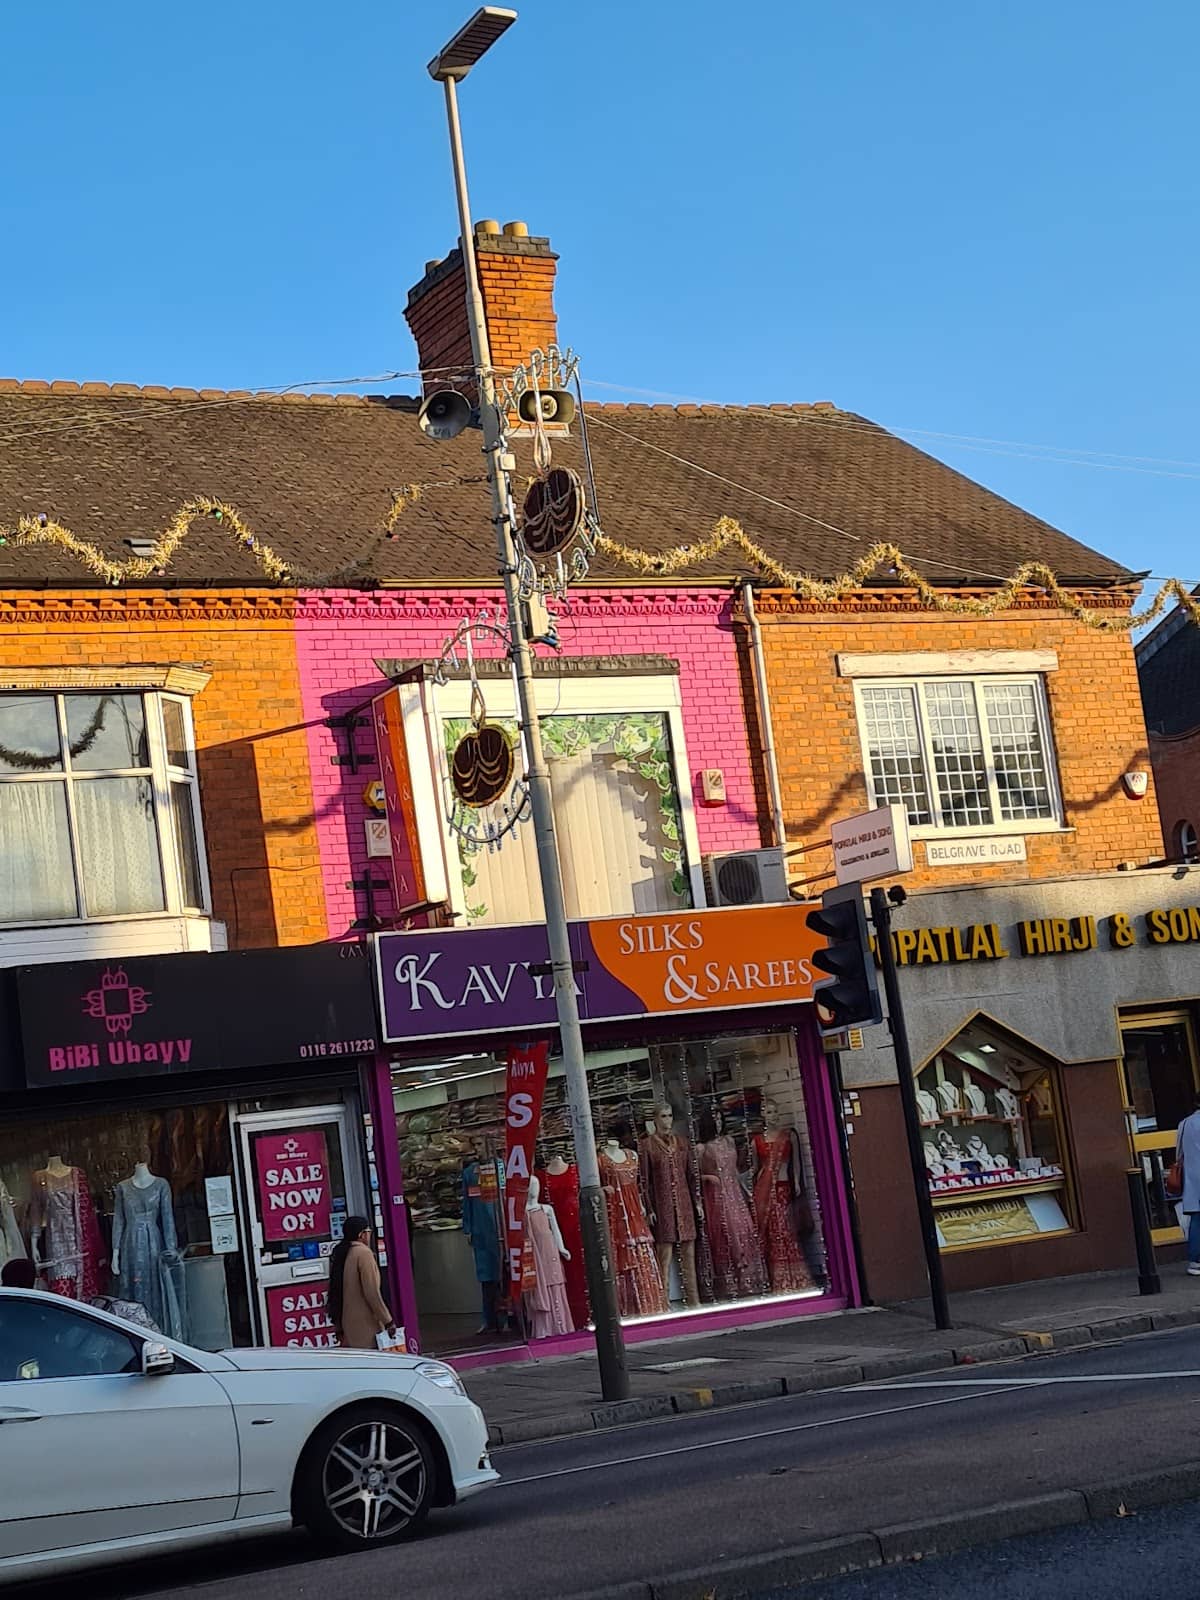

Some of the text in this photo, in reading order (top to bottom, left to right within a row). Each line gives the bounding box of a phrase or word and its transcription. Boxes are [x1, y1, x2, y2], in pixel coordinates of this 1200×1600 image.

[377, 713, 409, 895] KAVYA
[931, 845, 986, 859] BELGRAVE
[619, 921, 704, 955] SILKS
[1022, 915, 1098, 955] HIRJI
[1114, 912, 1137, 948] &
[395, 952, 584, 1010] KAVY
[663, 954, 812, 1004] & SAREES
[49, 1039, 192, 1071] BiBi Ubayy
[300, 1039, 375, 1058] 0116 2611233
[265, 1164, 323, 1187] SALE
[507, 1092, 534, 1282] SALE
[268, 1187, 322, 1210] NOW
[282, 1212, 315, 1232] ON
